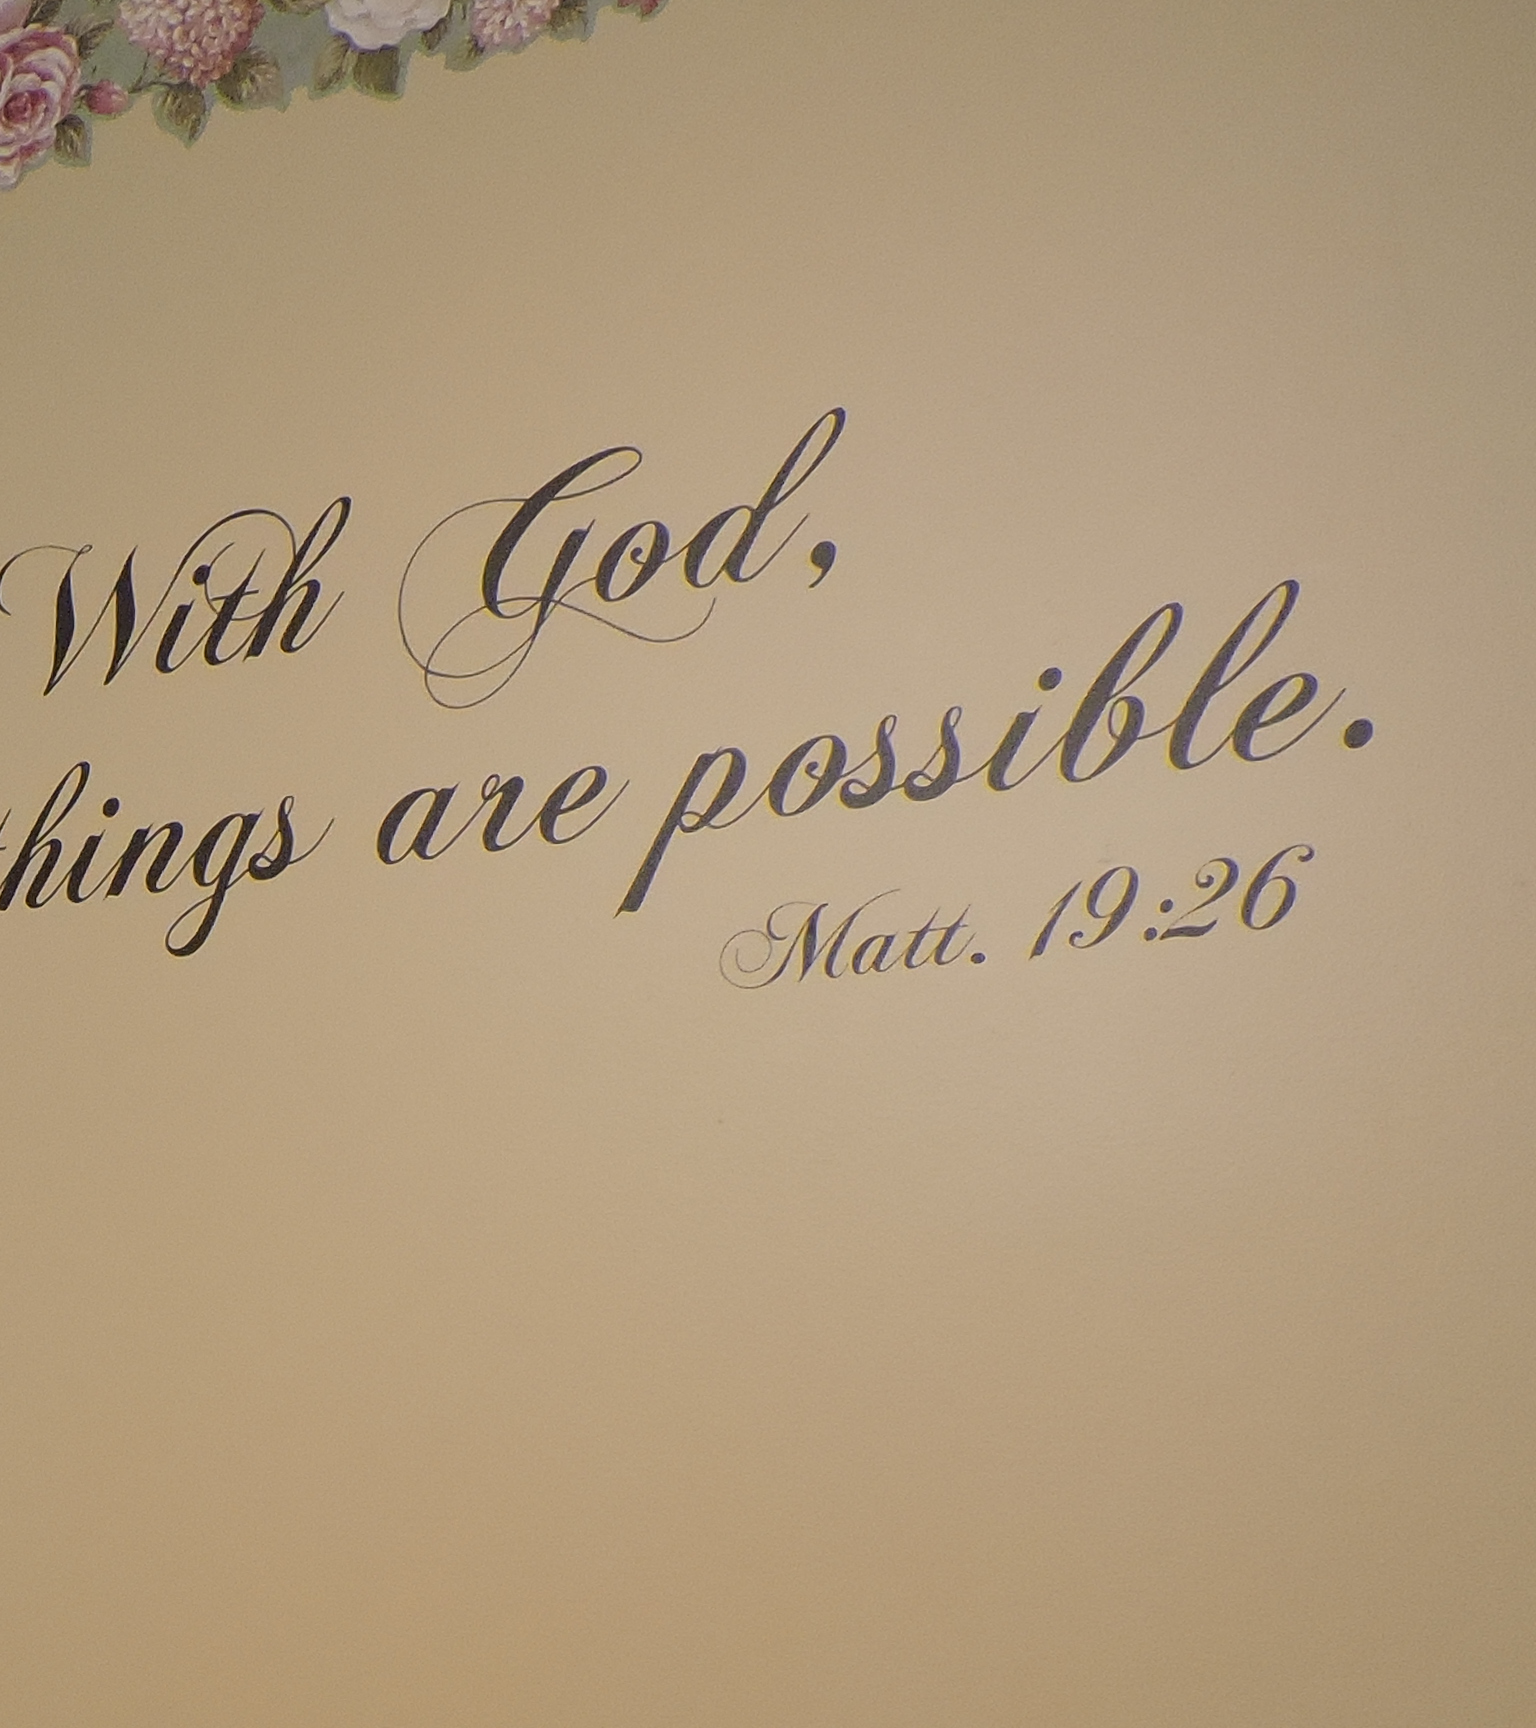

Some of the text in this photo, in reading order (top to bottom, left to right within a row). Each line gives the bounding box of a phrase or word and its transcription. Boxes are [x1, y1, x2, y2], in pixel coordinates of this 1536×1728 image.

[396, 406, 847, 711] God,
[375, 764, 631, 866] are
[613, 578, 1375, 918] possible.
[719, 842, 1316, 990] Matt. 19:26
